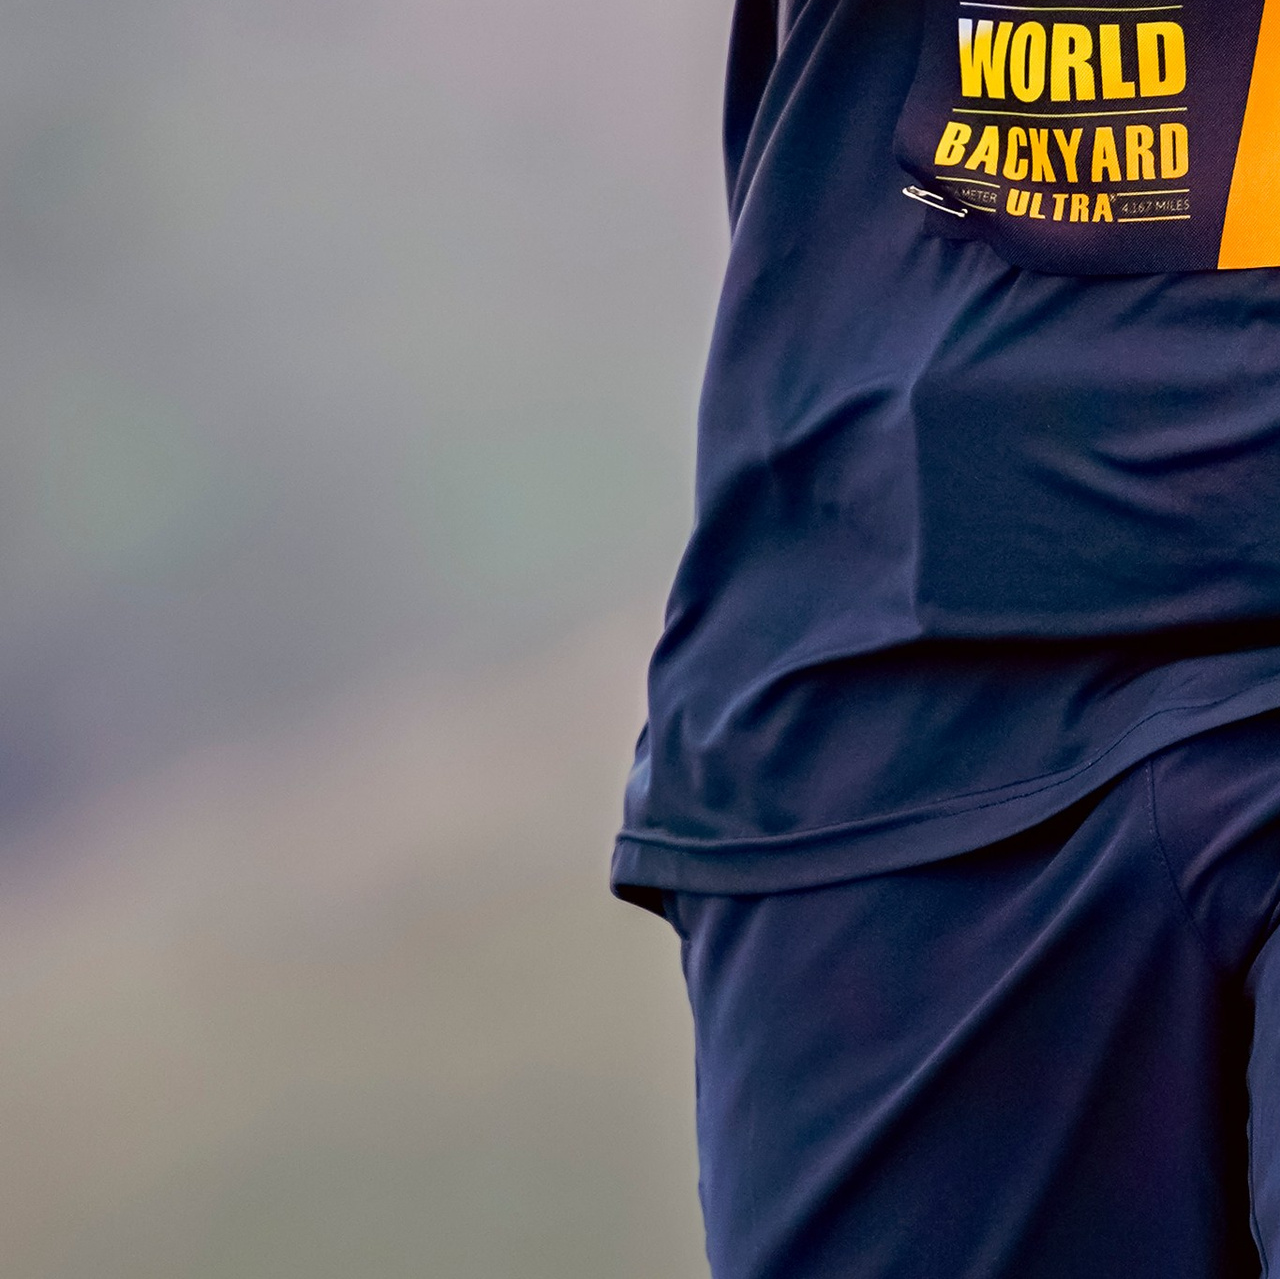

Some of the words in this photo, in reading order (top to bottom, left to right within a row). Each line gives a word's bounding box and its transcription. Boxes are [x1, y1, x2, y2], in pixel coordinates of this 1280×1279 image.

[958, 18, 1187, 103] WORLD
[934, 121, 1190, 183] BACKYARD
[1006, 188, 1114, 223] ULTRA
[1154, 197, 1190, 212] MILES
